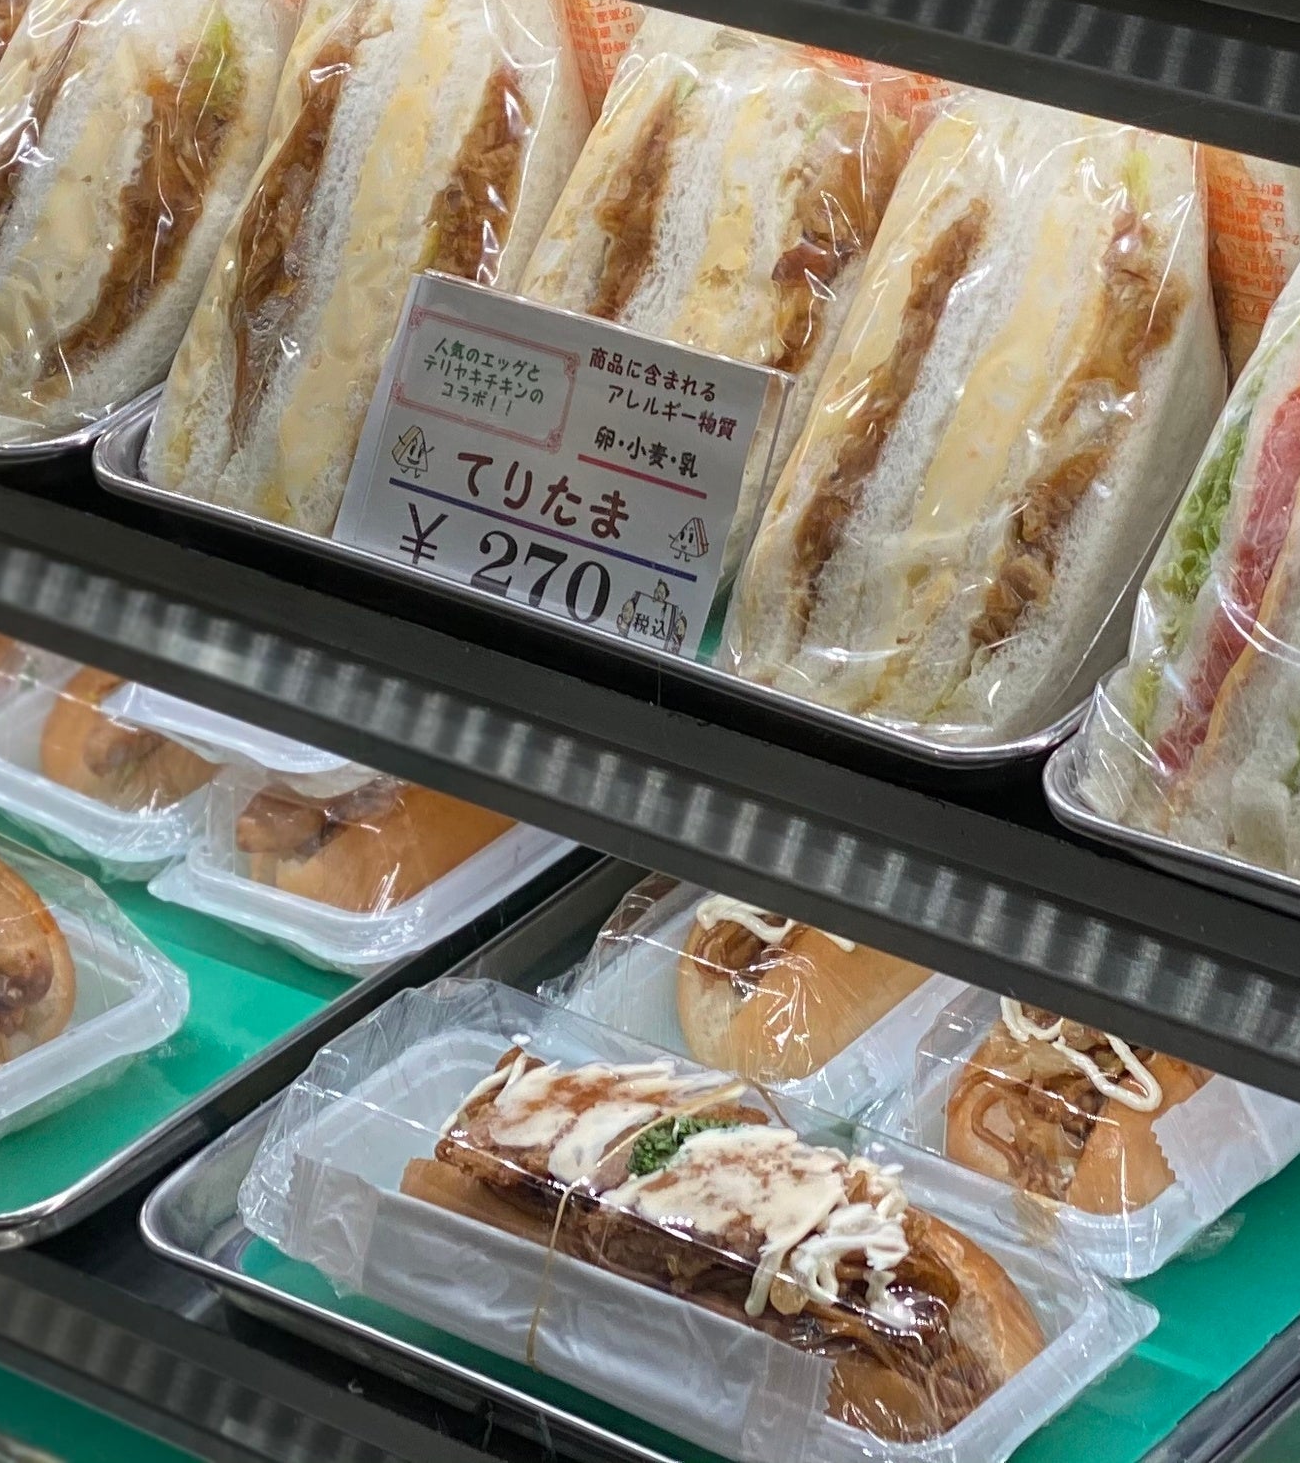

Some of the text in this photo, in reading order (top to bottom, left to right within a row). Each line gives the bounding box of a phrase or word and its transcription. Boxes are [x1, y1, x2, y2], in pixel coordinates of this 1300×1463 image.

[423, 355, 544, 405] テリヤキチキンの
[434, 337, 541, 383] 人気のエッグと
[589, 347, 716, 402] 商品に含まれる
[607, 384, 738, 441] アレルギー物質
[594, 425, 698, 479] 卵・小麦・乳
[456, 451, 630, 540] てりたま
[632, 612, 666, 638] 税込
